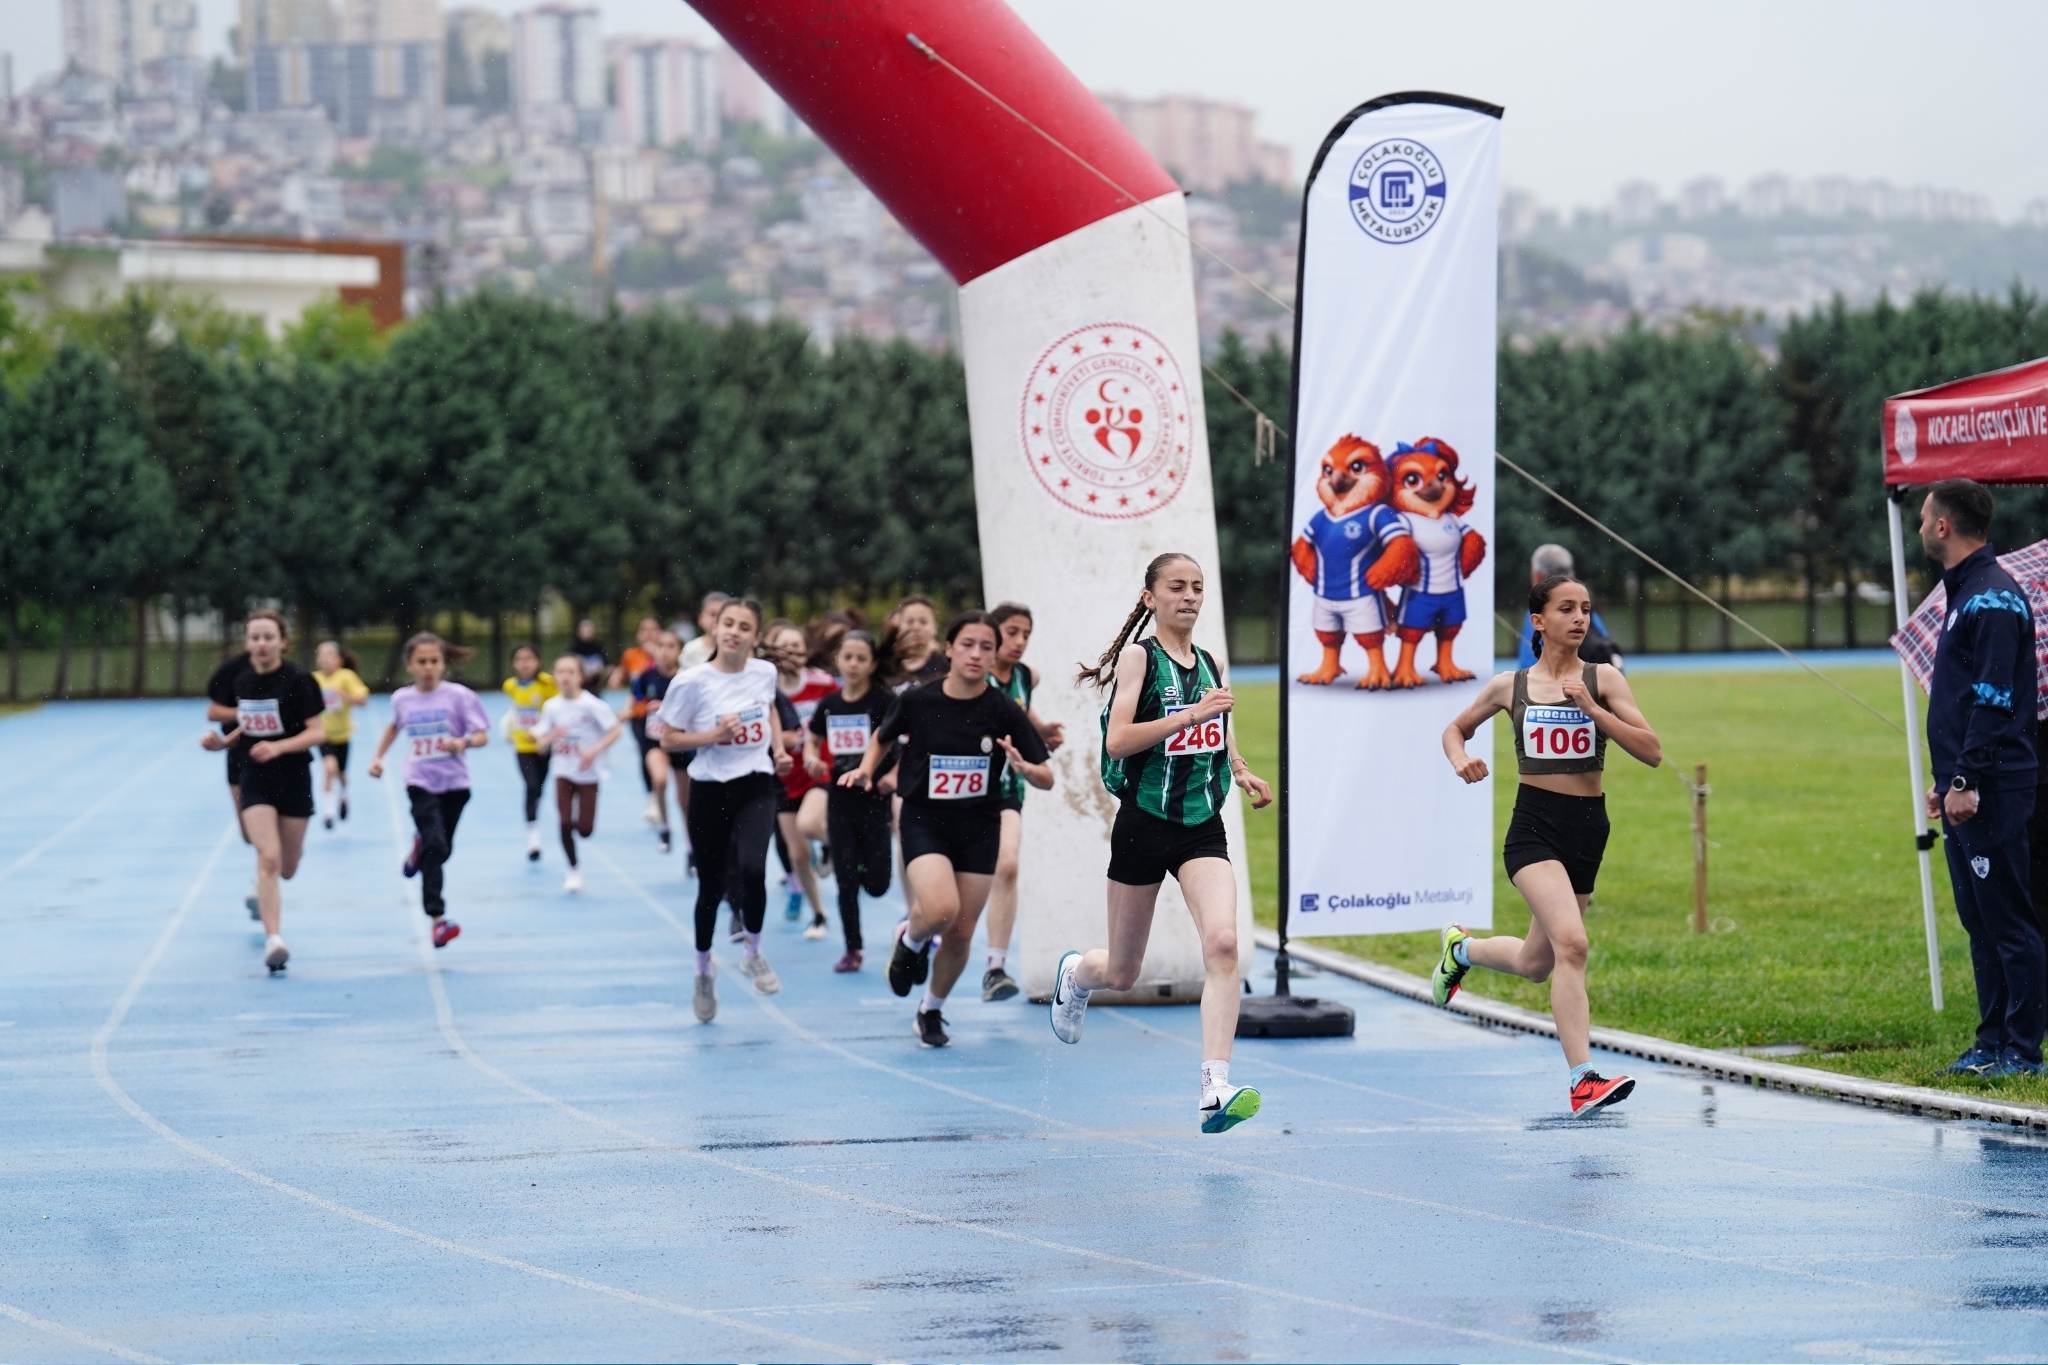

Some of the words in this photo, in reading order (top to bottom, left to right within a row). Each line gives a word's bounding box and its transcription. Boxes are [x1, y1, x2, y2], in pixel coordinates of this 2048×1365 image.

[1358, 144, 1438, 180] ÇOLAKOĞLU
[1928, 407, 1978, 446] KOCAELİ
[1977, 402, 2031, 447] GENÇLİK
[2030, 404, 2047, 435] VE
[242, 713, 278, 731] 288
[832, 730, 864, 749] 269
[1167, 722, 1221, 752] 246
[1529, 727, 1591, 754] 106
[933, 772, 983, 794] 278
[1328, 893, 1410, 912] Çolakoğlu
[1415, 887, 1473, 905] Metalurji
